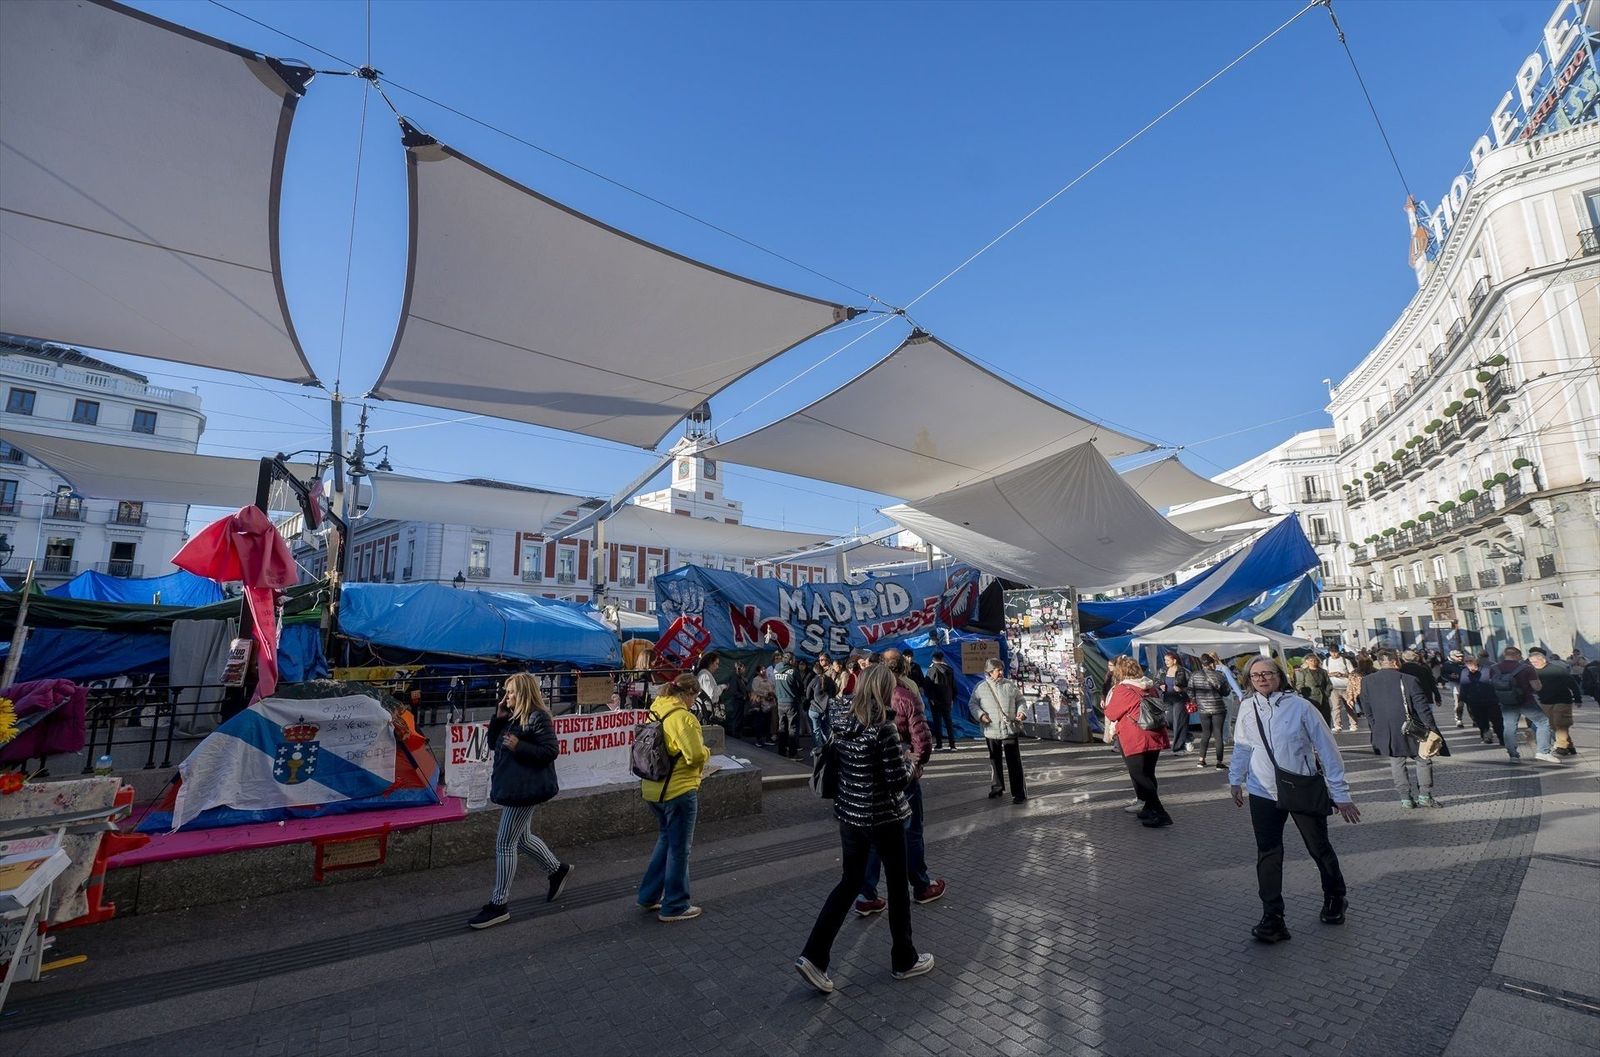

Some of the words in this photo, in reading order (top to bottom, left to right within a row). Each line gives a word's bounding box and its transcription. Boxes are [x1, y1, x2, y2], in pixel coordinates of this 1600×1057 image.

[728, 602, 795, 655] NO
[801, 622, 851, 653] SE
[450, 726, 464, 743] SI
[553, 717, 594, 736] FRISTE
[596, 711, 635, 731] ABUSOS
[637, 710, 651, 725] PO
[573, 731, 626, 753] CUÉNTALO
